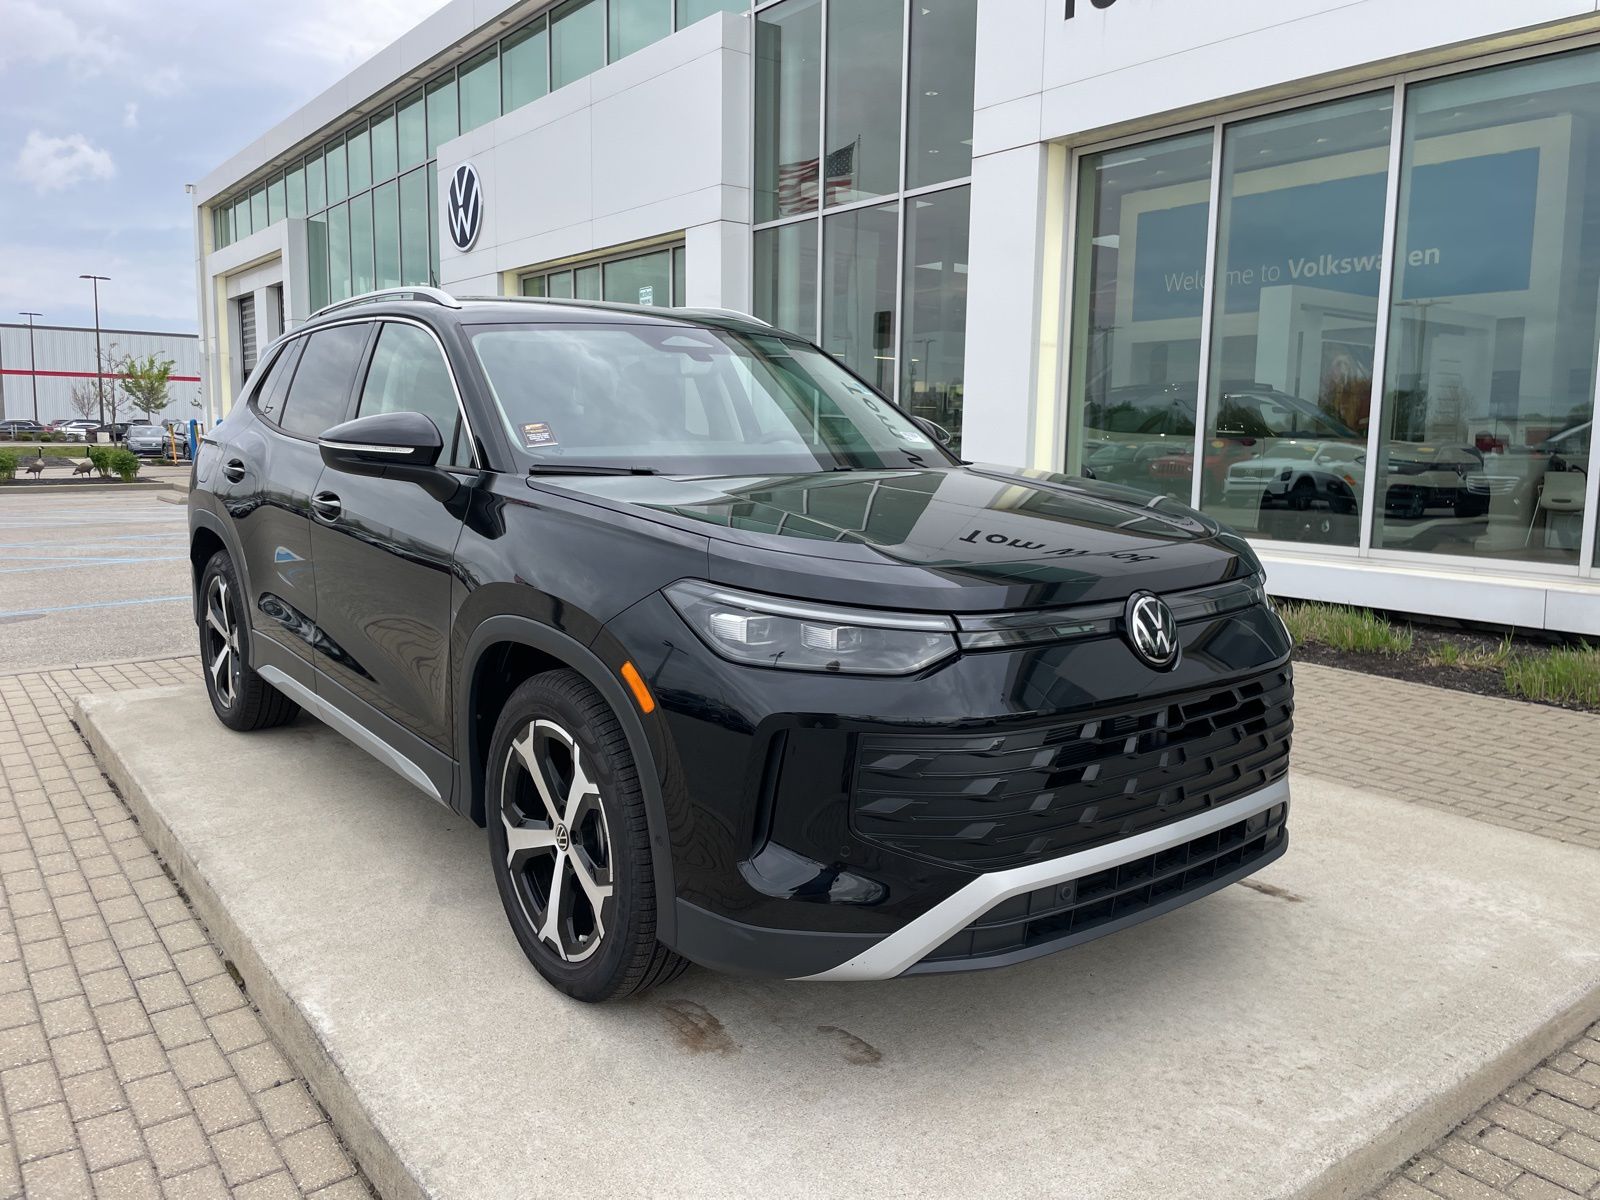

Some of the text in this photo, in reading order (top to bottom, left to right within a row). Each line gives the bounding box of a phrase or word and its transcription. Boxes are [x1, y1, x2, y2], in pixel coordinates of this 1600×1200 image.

[448, 163, 483, 252] VW
[1165, 247, 1440, 293] Welcme to Volkswaen
[1132, 596, 1177, 664] VW
